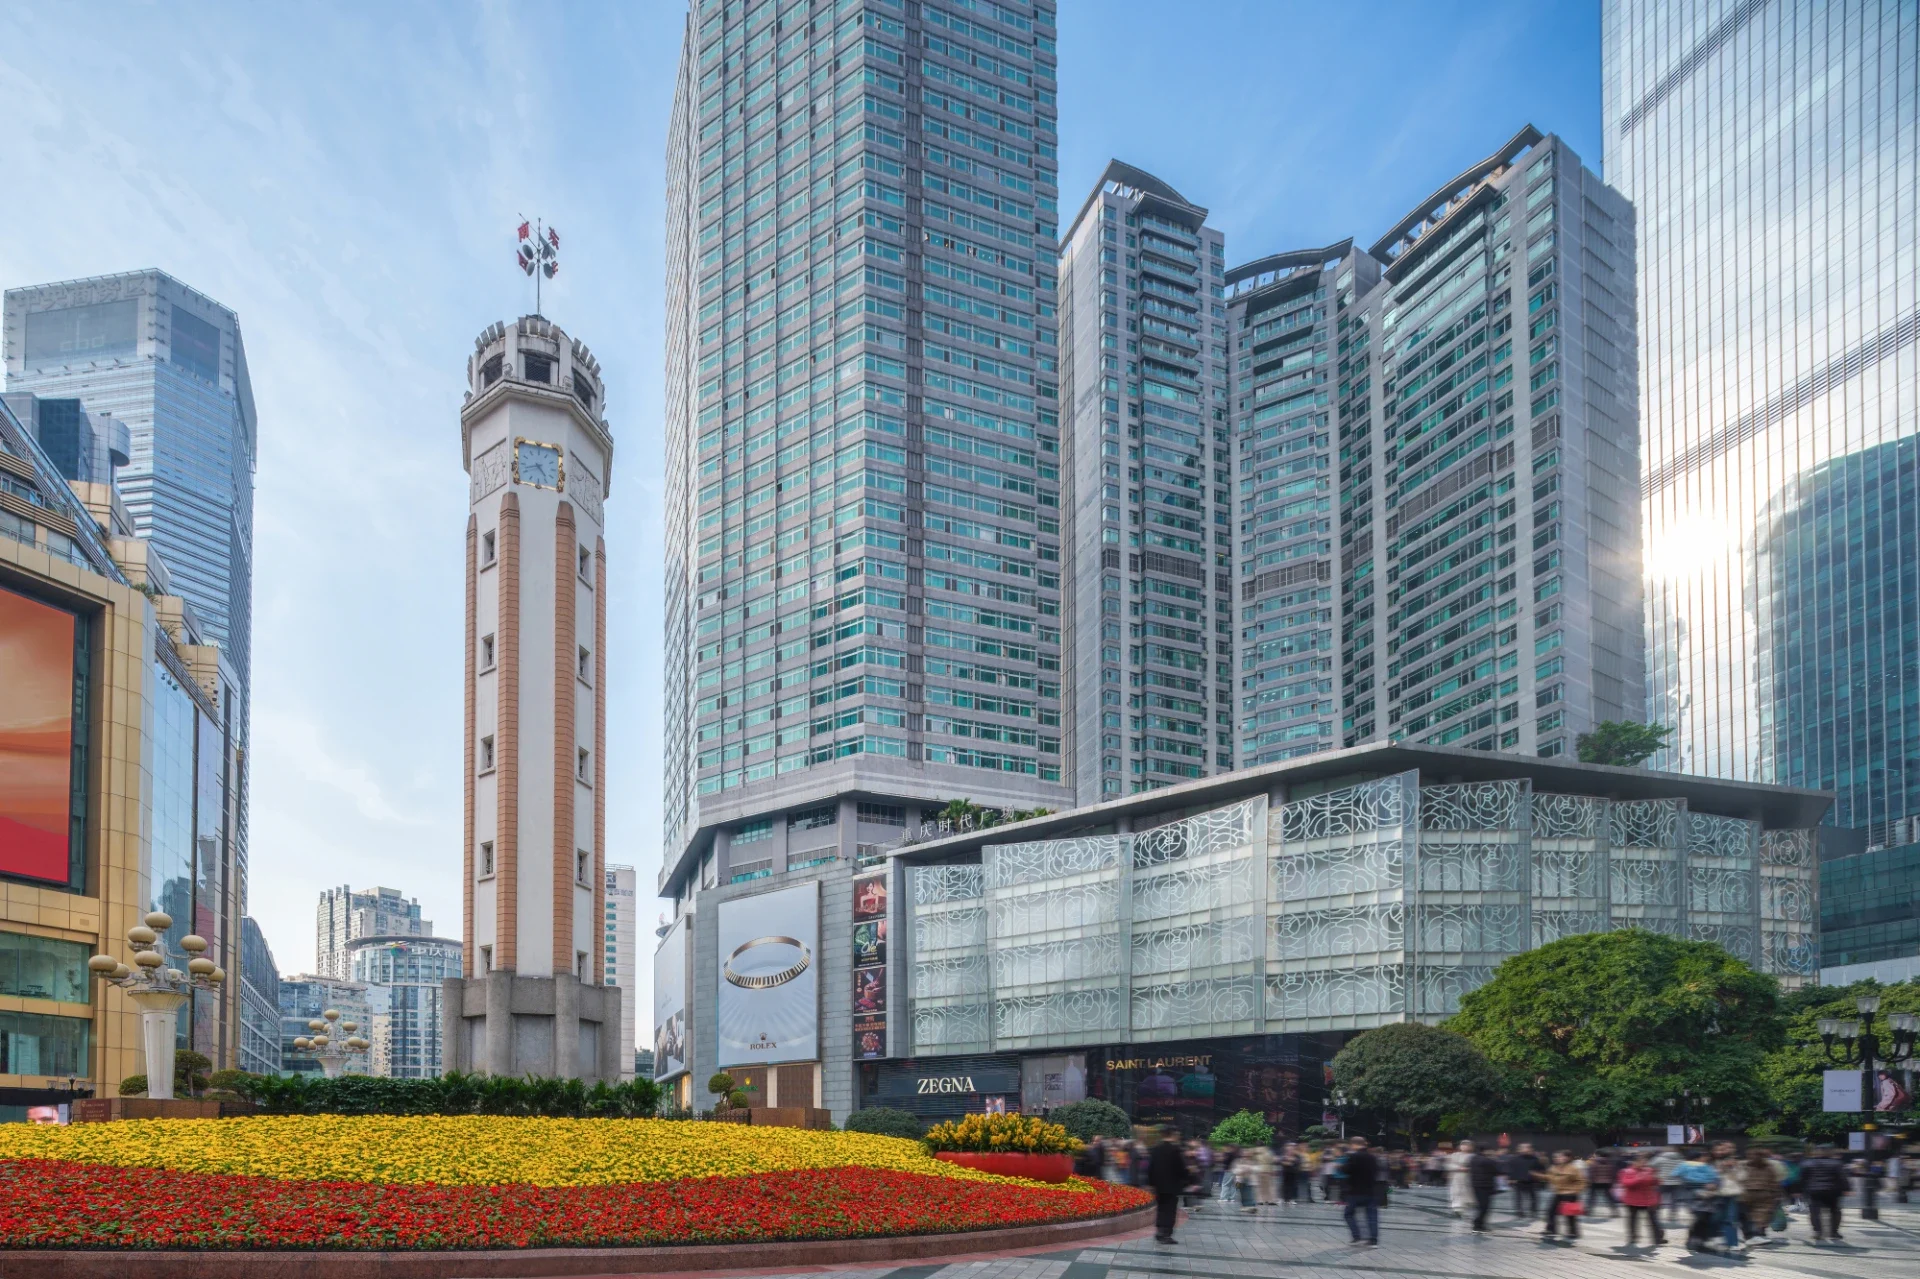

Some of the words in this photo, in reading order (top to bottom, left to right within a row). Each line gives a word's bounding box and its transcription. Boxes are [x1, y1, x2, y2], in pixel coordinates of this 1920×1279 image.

[18, 276, 147, 313] 中央商务区
[901, 804, 1016, 841] 重庆时代广场
[749, 1042, 777, 1050] ROLEX
[1106, 1058, 1145, 1071] SAINT
[1147, 1055, 1212, 1068] LAURENT
[917, 1076, 976, 1094] ZEGNA
